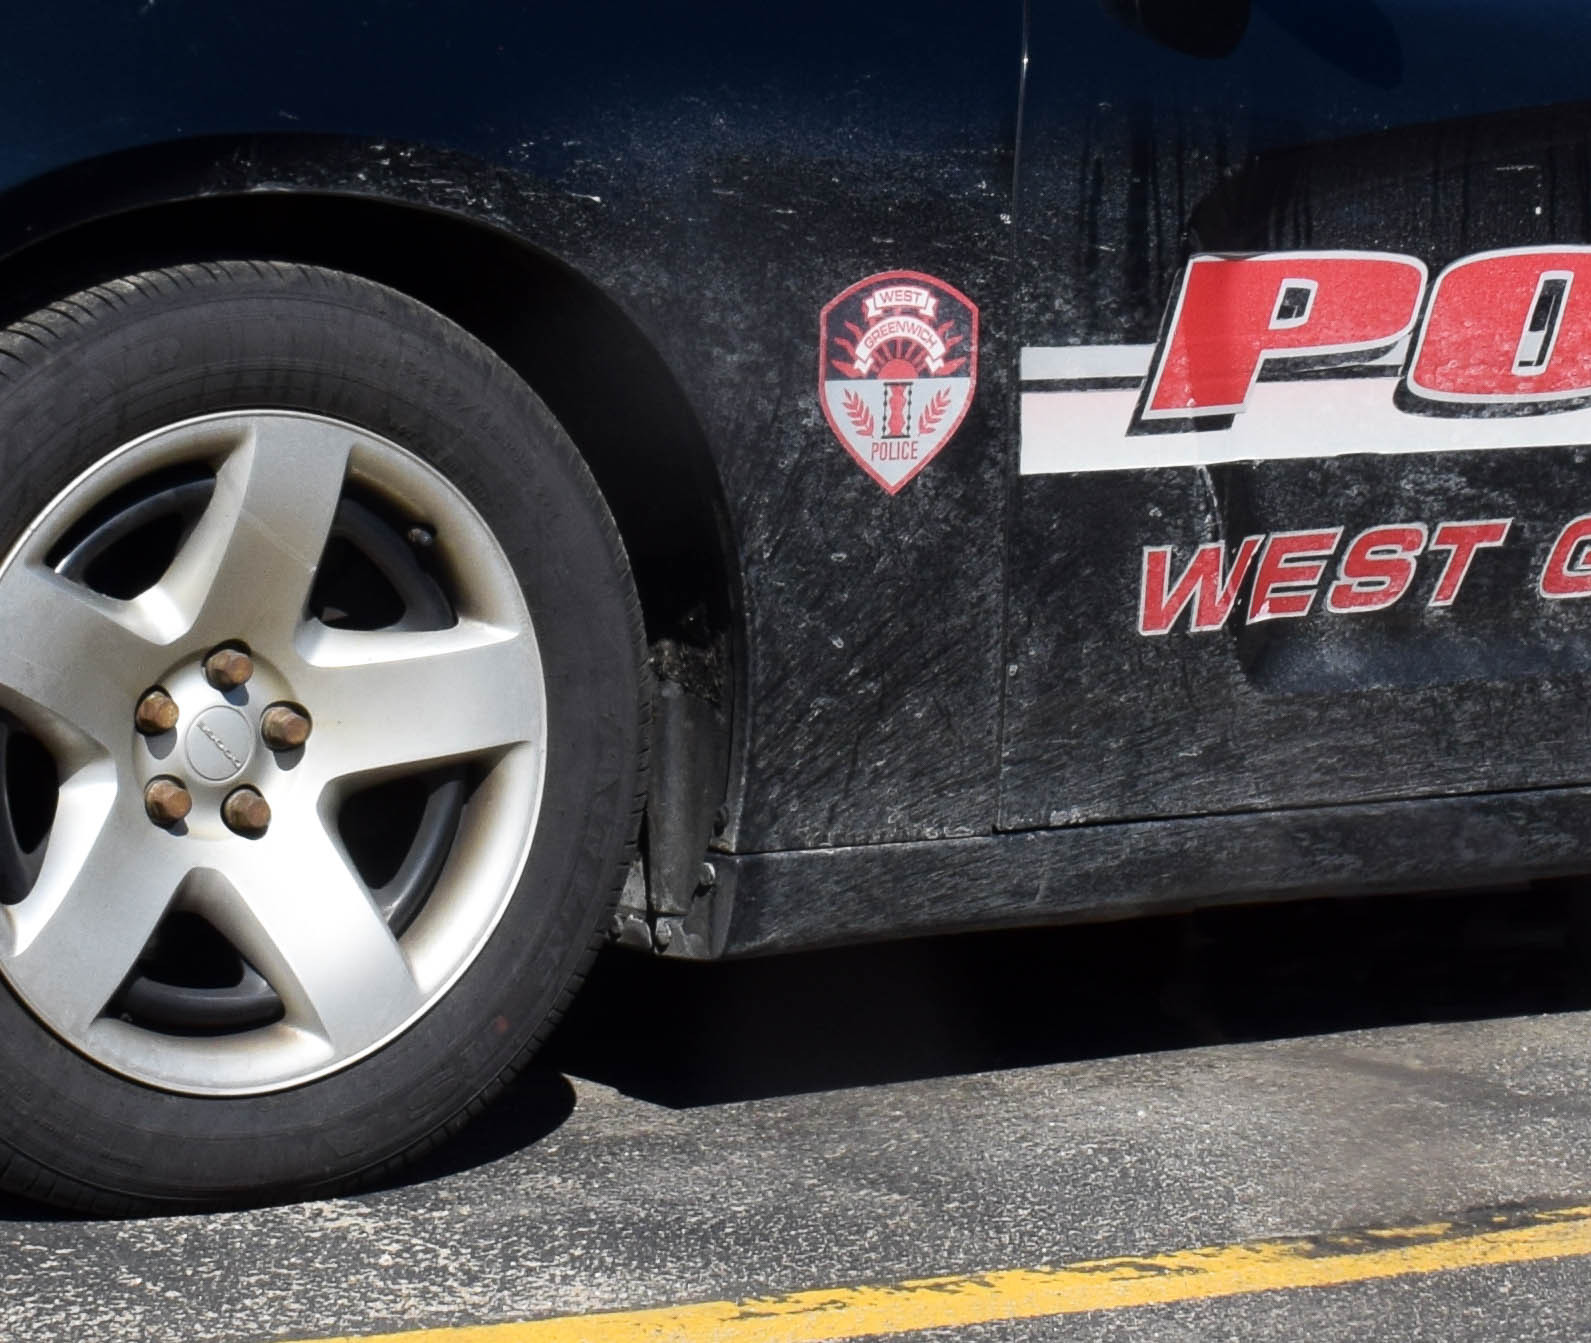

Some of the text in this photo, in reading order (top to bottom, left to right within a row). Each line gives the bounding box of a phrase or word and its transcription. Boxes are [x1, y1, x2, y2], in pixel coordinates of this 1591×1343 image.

[879, 290, 923, 304] WEST
[864, 320, 938, 350] GREENWICH
[870, 440, 919, 461] POLICE
[1138, 517, 1513, 636] WEST
